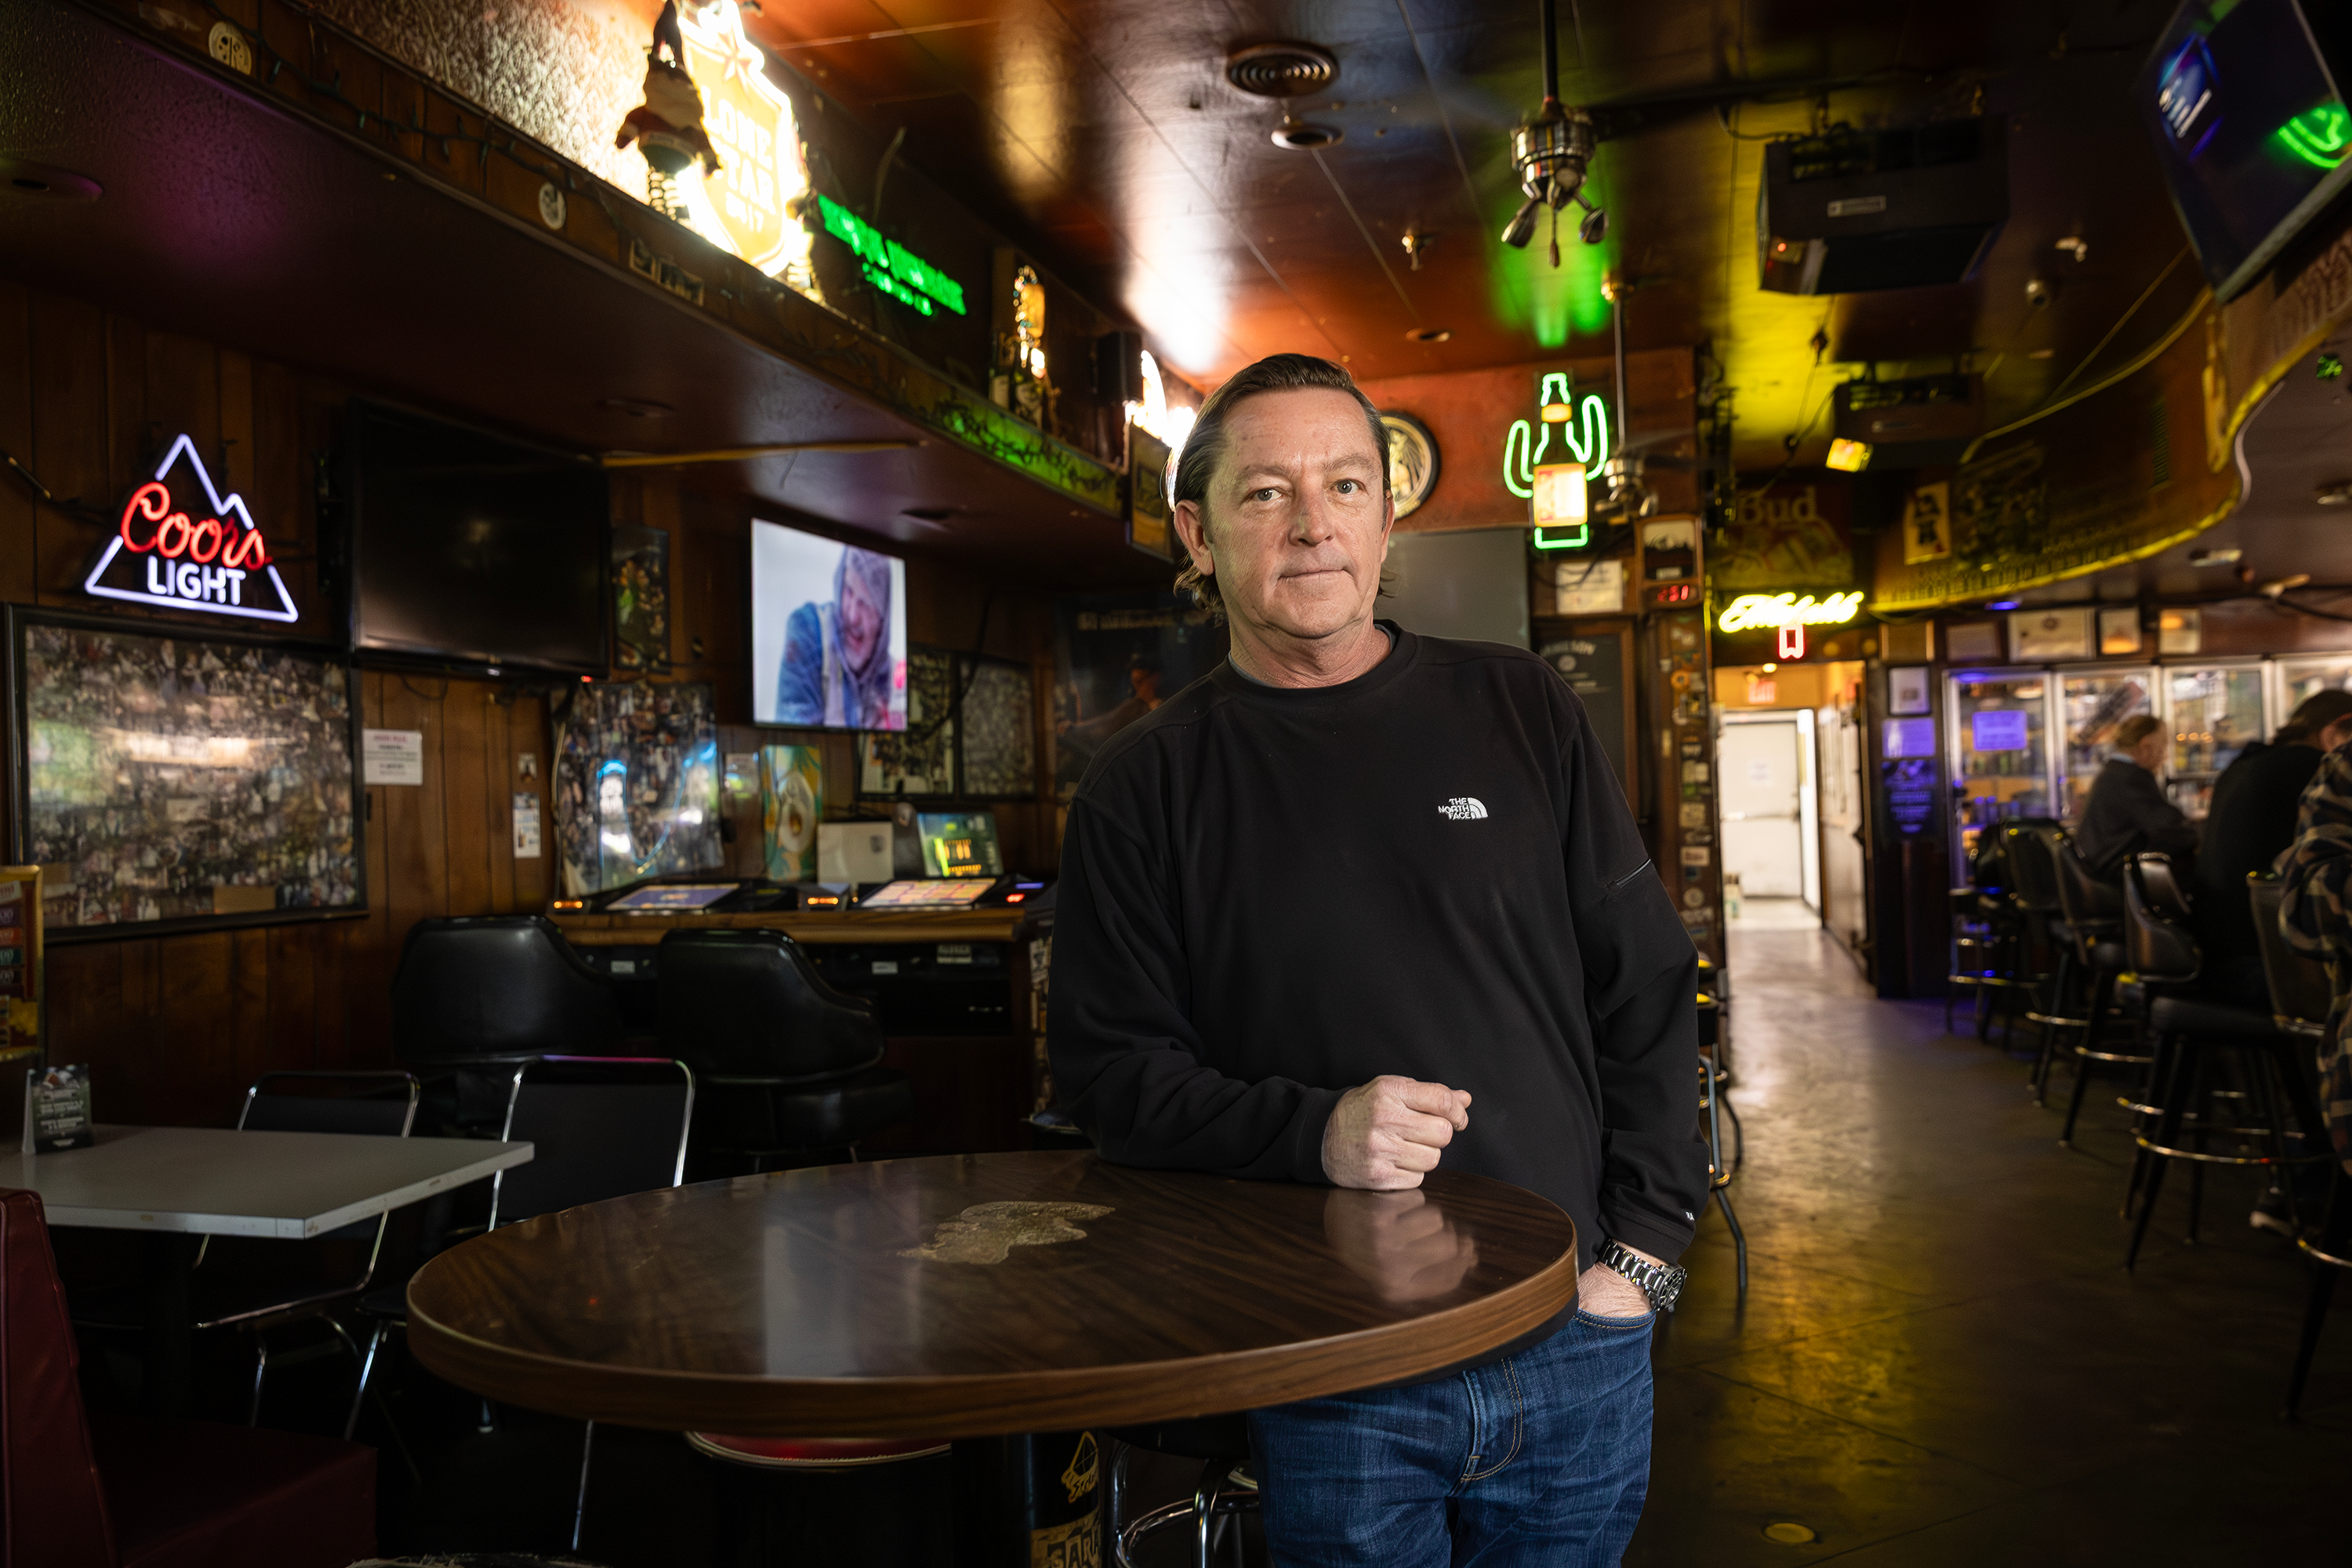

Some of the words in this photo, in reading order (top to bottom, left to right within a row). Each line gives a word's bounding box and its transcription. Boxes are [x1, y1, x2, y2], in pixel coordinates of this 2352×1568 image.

[702, 85, 772, 170] LONE
[121, 481, 267, 572] Coors
[1734, 485, 1817, 527] Bud
[147, 554, 247, 606] LIGHT
[1438, 804, 1469, 814] NORTH
